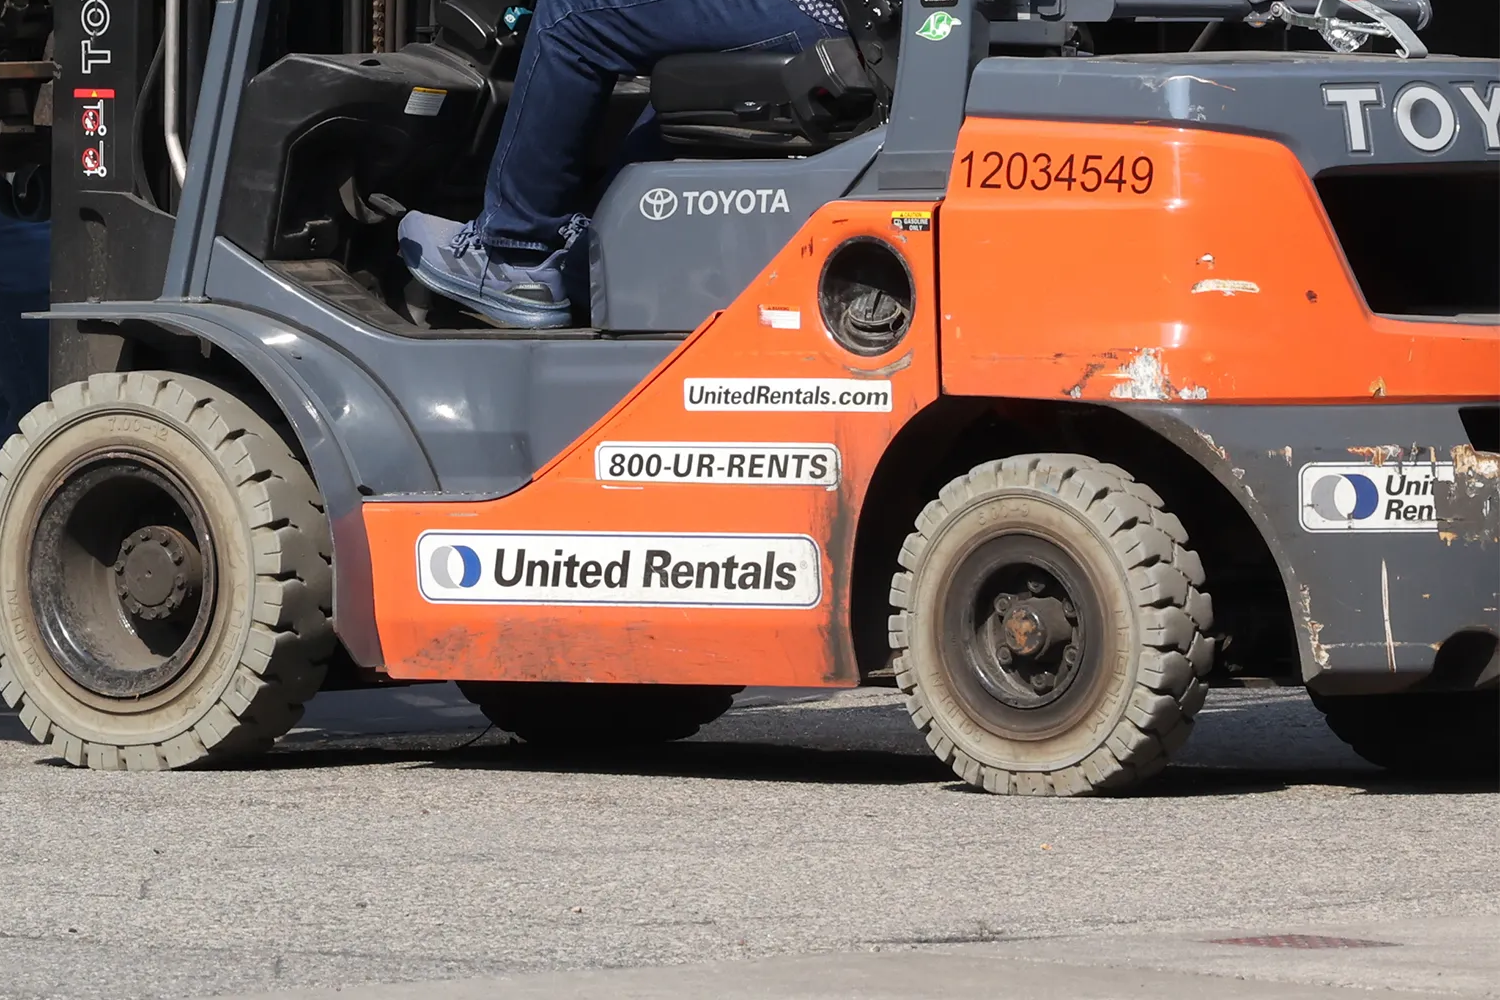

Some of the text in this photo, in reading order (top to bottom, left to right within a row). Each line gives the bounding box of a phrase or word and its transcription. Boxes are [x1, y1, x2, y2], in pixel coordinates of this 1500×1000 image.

[960, 150, 1154, 195] 12034549
[682, 188, 790, 216] TOYOTA
[689, 385, 889, 407] UnitedRentals.com
[609, 453, 828, 479] 800-UR-RENTS
[494, 548, 798, 591] United Rentals
